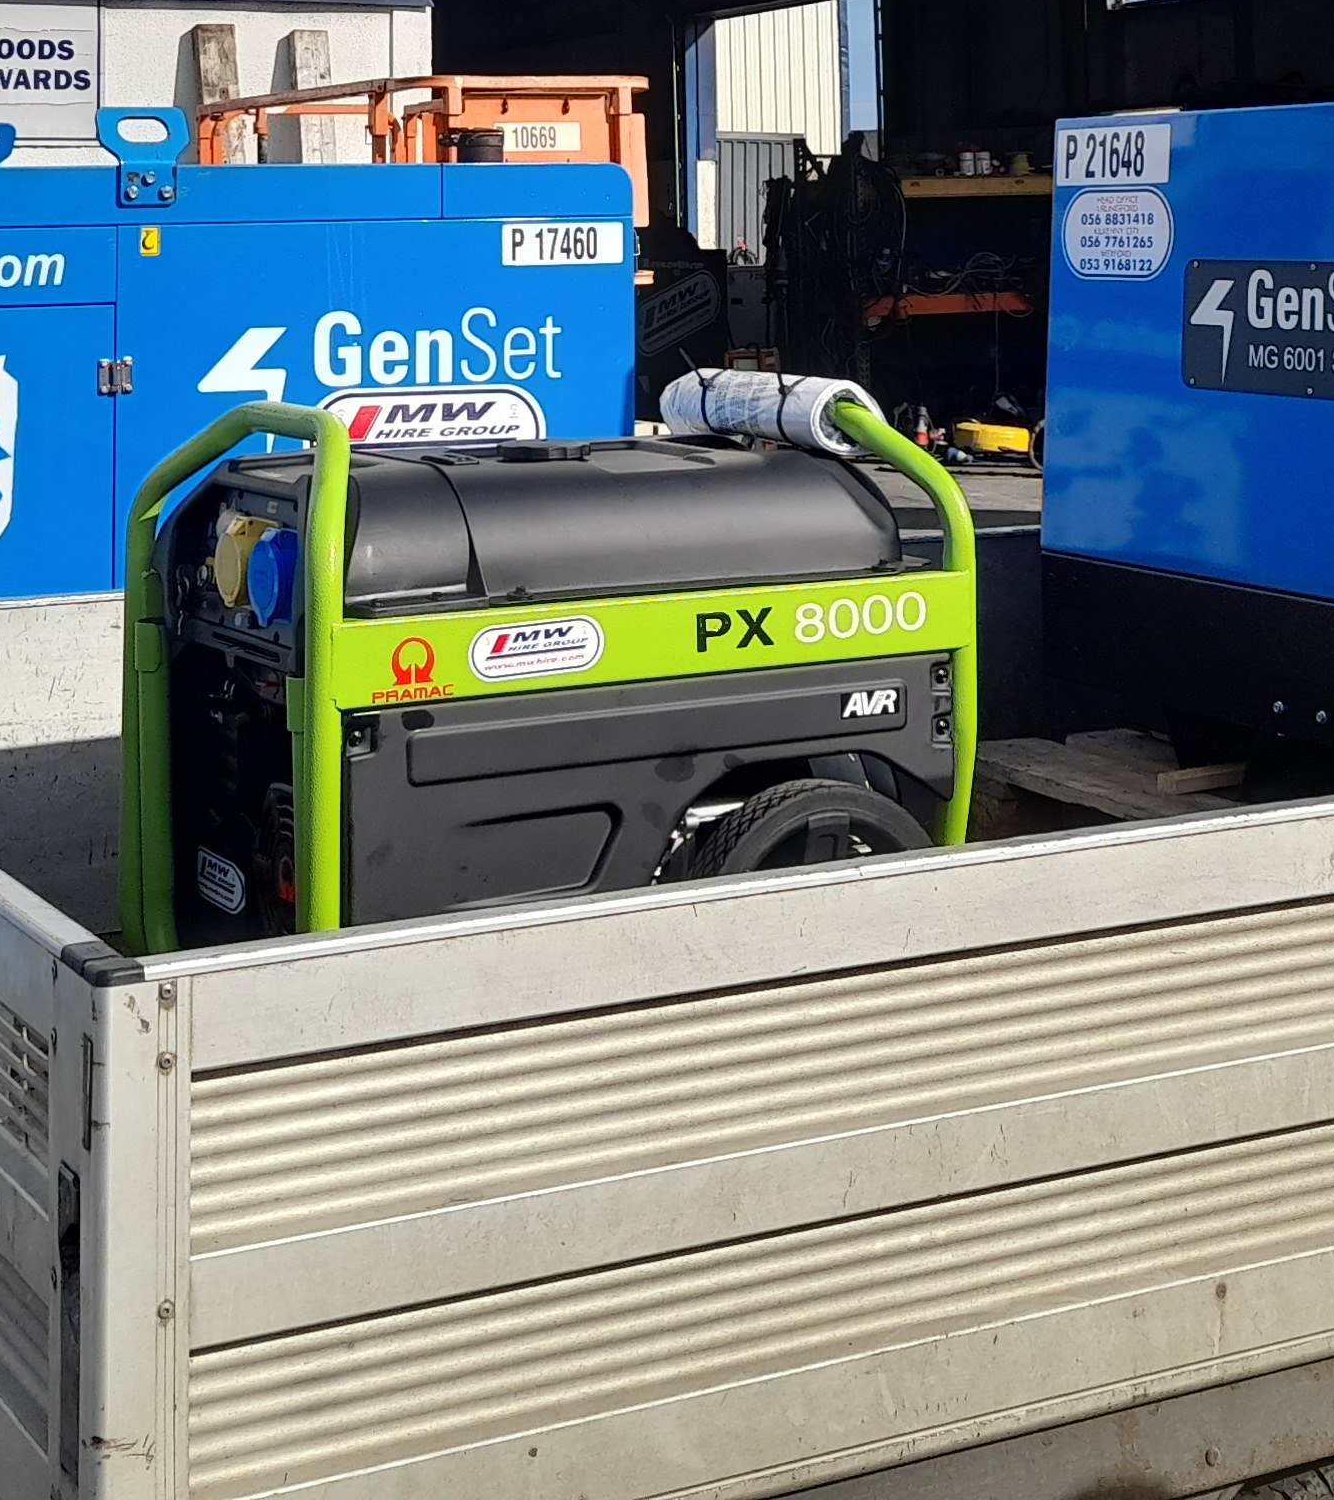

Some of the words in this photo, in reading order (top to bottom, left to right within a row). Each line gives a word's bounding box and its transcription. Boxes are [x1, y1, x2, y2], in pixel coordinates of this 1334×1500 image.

[512, 126, 556, 148] 10669
[1065, 135, 1078, 179] P
[1085, 130, 1145, 179] 21648
[1081, 213, 1101, 225] 056
[1105, 213, 1154, 225] 8831418
[512, 228, 524, 261] P
[535, 227, 597, 260] 17460
[1081, 236, 1101, 248] 056
[1105, 236, 1153, 248] 7761265
[1080, 259, 1099, 270] 053
[1104, 259, 1152, 271] 9168122
[314, 306, 561, 387] GenSet
[1249, 344, 1279, 369] MG
[1283, 347, 1325, 373] 6001
[384, 402, 497, 423] MW
[375, 427, 434, 439] HIRE
[439, 424, 520, 437] GROUP
[695, 606, 775, 653] PX
[793, 591, 927, 643] 8000
[512, 626, 574, 643] MW
[508, 643, 540, 651] HIRE
[371, 683, 454, 705] PRAMAC
[843, 687, 899, 719] AVR
